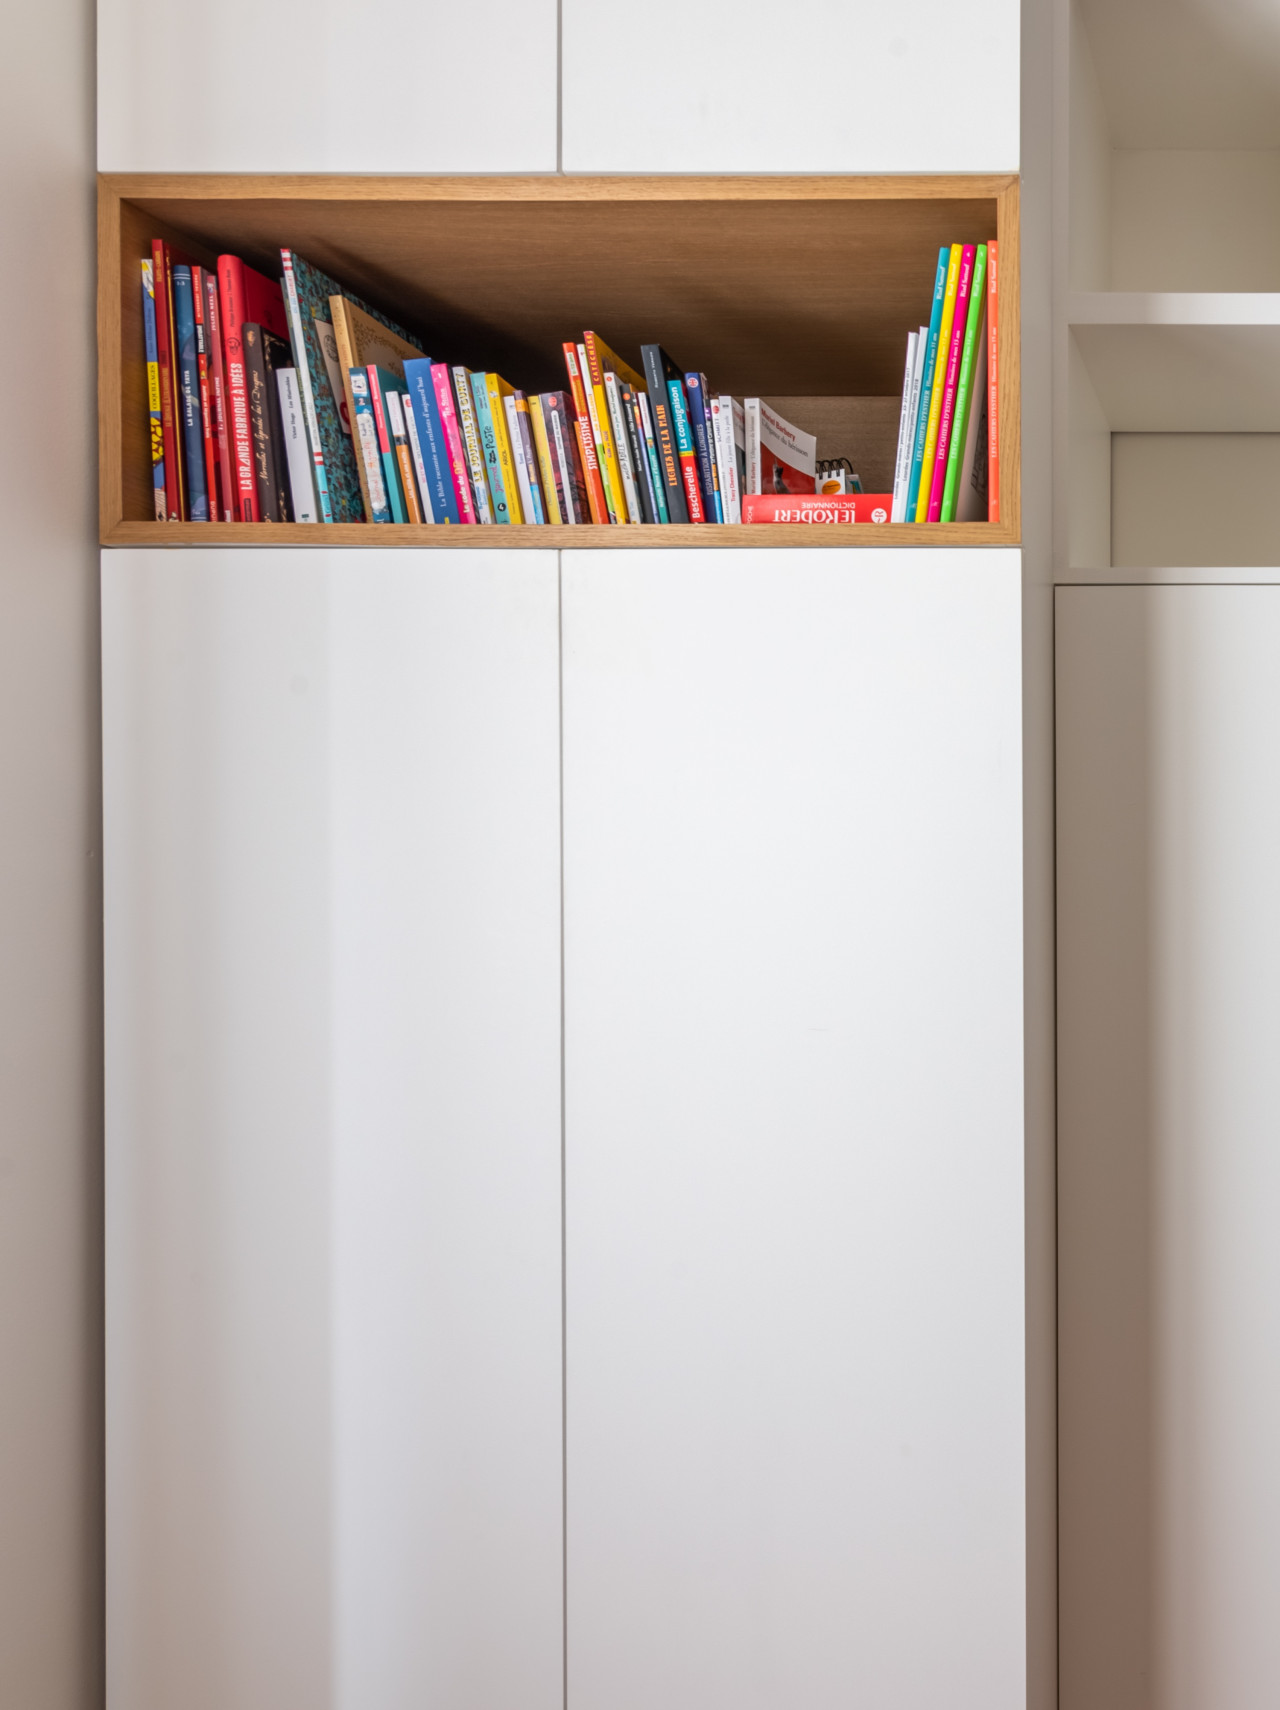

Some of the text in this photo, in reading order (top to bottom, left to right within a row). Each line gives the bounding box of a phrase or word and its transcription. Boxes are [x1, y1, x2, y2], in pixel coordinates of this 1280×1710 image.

[938, 265, 946, 286] Sattouf
[962, 264, 970, 284] Sattouf
[150, 364, 158, 409] COQUILLAGES
[230, 362, 244, 387] IDÉES
[417, 376, 430, 418] d'aujourd'hui
[921, 390, 930, 421] D'ESTHER
[944, 388, 954, 419] D'ESTHER
[187, 418, 194, 426] LA
[234, 396, 248, 438] FABRIQUE
[425, 418, 435, 442] enfants
[455, 372, 482, 482] LE JOURNAL DE GURTY
[671, 386, 688, 449] La conjugaison
[761, 407, 796, 442] Muriel Barbery
[578, 416, 598, 470] SIMPLISSIME
[656, 404, 678, 486] LIGNES DE LA MAIN
[696, 424, 706, 450] LONDRES
[918, 422, 926, 448] CAHIERS
[940, 420, 949, 448] CAHIERS
[238, 441, 252, 478] GRANDE
[432, 454, 442, 480] racontée
[242, 480, 252, 490] LA
[436, 480, 444, 497] Bible
[685, 466, 700, 518] Bescherelle
[701, 457, 713, 496] DISPARITION
[440, 498, 447, 507] La
[458, 476, 470, 513] Le code du
[209, 500, 217, 522] DUPUI
